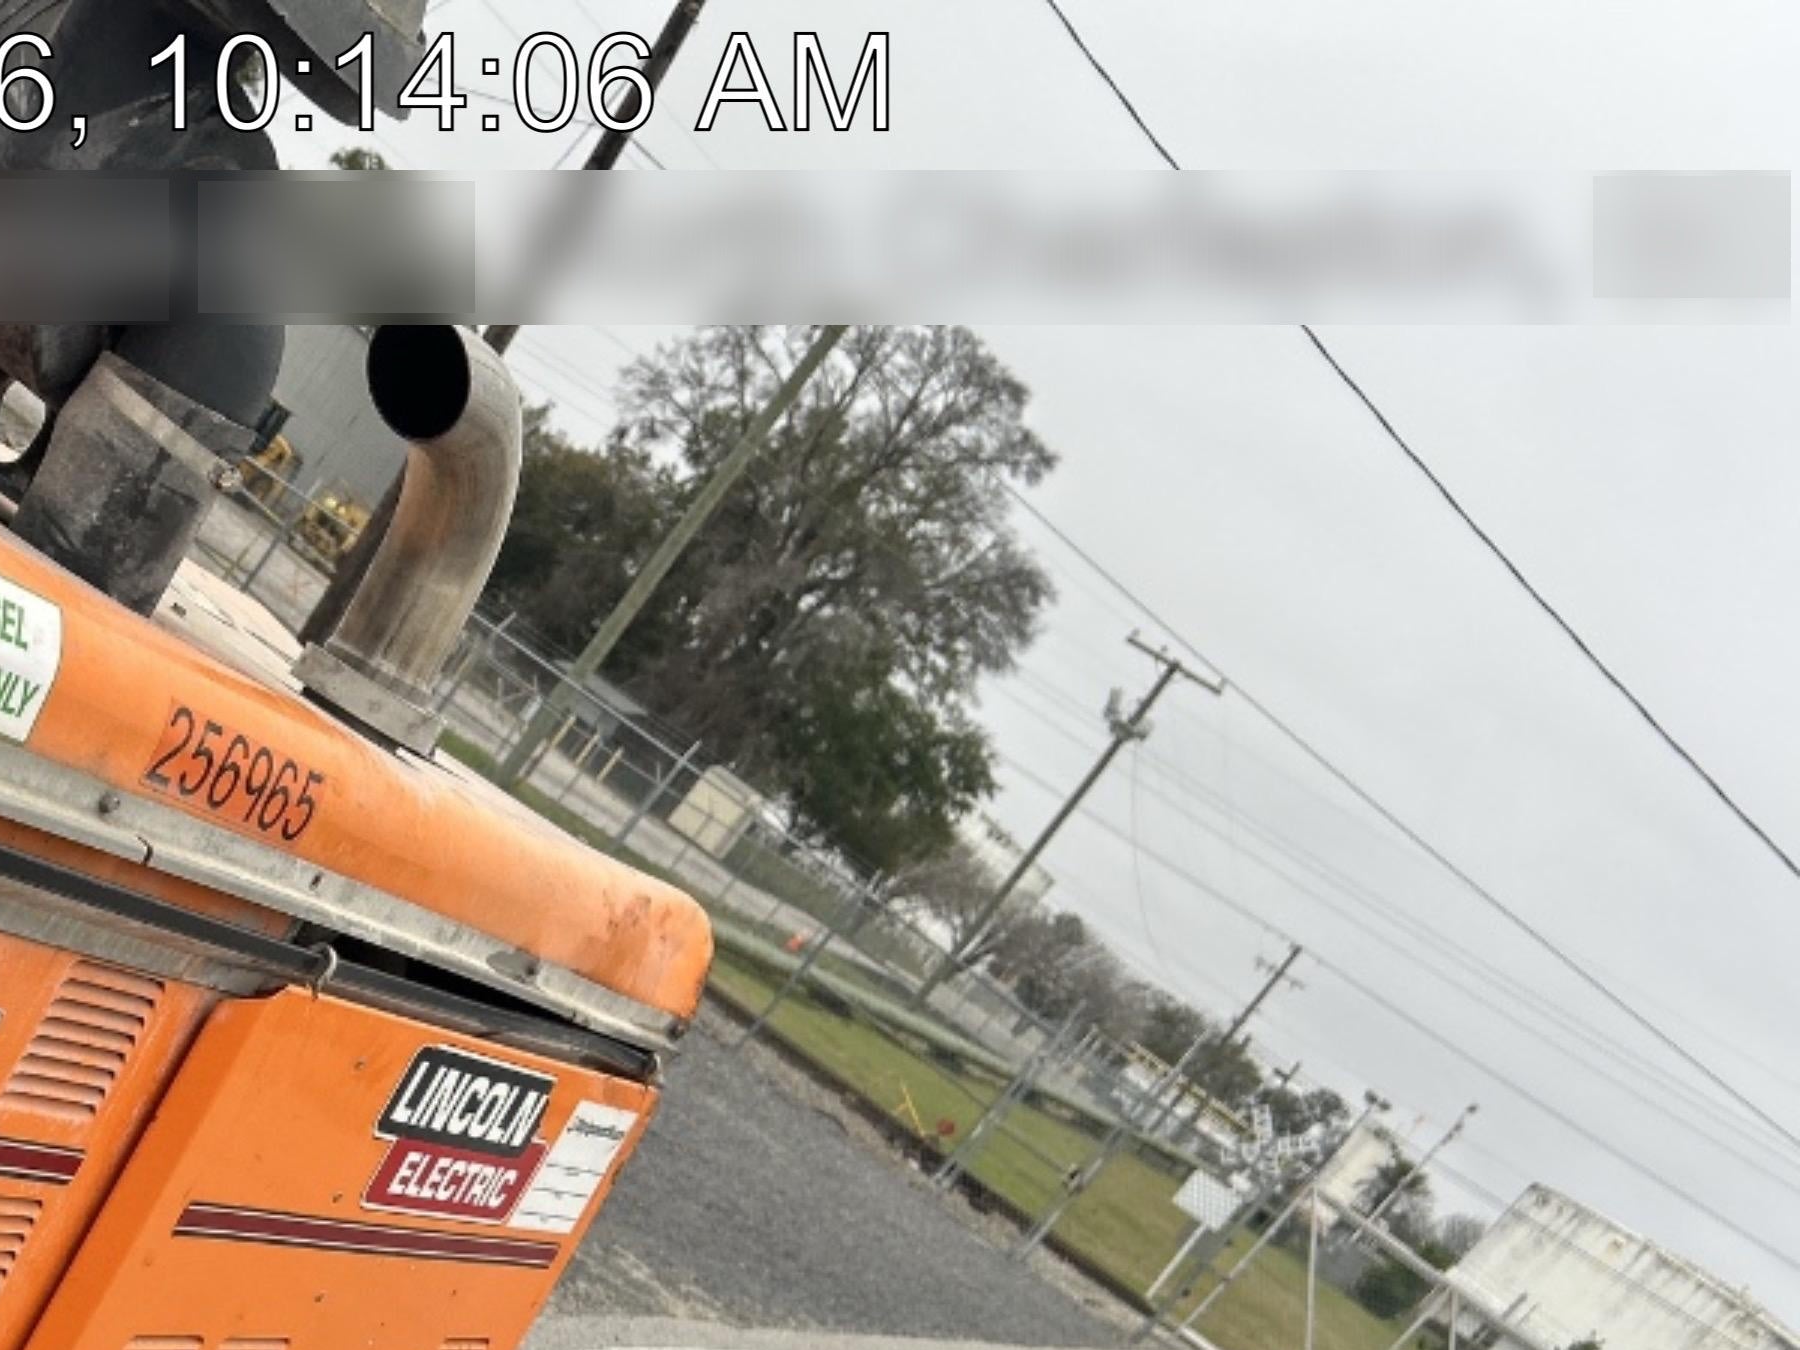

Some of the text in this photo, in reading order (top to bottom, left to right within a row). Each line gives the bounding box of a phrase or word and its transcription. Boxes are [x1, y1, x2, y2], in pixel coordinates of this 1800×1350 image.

[142, 705, 326, 842] 256965
[389, 1060, 550, 1148] LINCOLN
[387, 1151, 519, 1209] ELECTRIC
